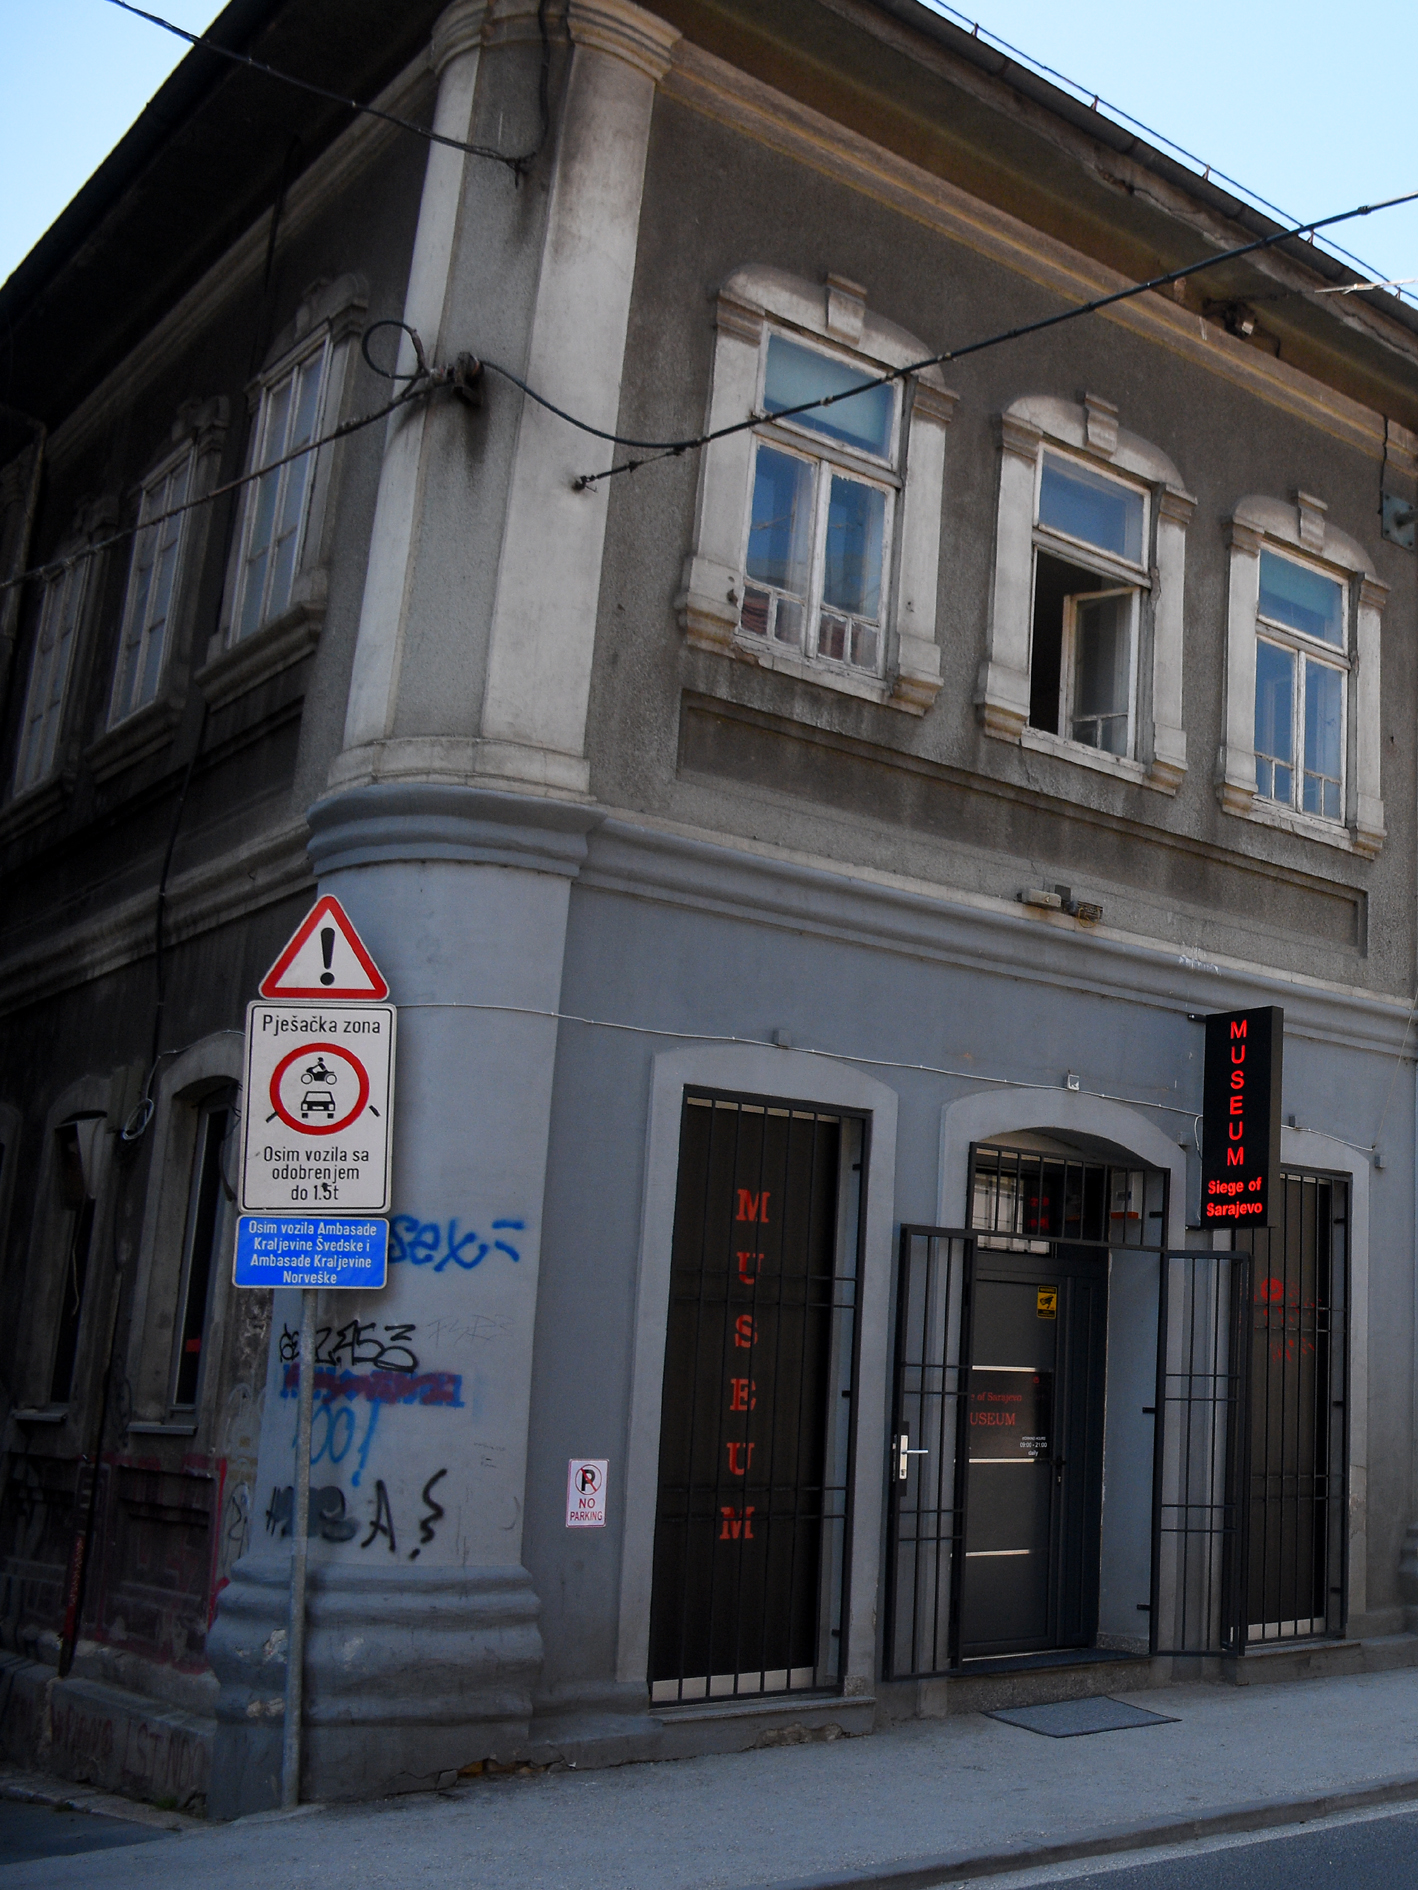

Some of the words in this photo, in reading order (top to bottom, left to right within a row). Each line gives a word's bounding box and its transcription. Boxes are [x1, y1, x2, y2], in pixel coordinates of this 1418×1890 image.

[262, 1014, 338, 1036] Pješačka
[343, 1020, 381, 1034] zona
[1227, 1019, 1247, 1166] MUSEUM
[263, 1146, 300, 1162] Osim
[305, 1146, 347, 1162] vozila
[352, 1150, 369, 1162] sa
[272, 1164, 359, 1184] odobrenjem
[291, 1185, 308, 1200] do
[1207, 1180, 1244, 1196] Siege
[1248, 1177, 1262, 1191] of
[1206, 1202, 1263, 1218] Sarajevo
[249, 1220, 277, 1234] Osim
[281, 1222, 314, 1234] vozila
[317, 1222, 377, 1236] Ambasade
[254, 1237, 313, 1253] Kraljevine
[316, 1236, 363, 1251] Švedske
[366, 1240, 370, 1251] i
[250, 1254, 311, 1267] Ambasade
[314, 1255, 372, 1271] Kraljevine
[283, 1271, 337, 1284] Norveške
[719, 1188, 771, 1540] MUSEUM
[970, 1412, 1016, 1426] USEUM
[579, 1498, 595, 1508] NO
[570, 1511, 602, 1521] PARKING
